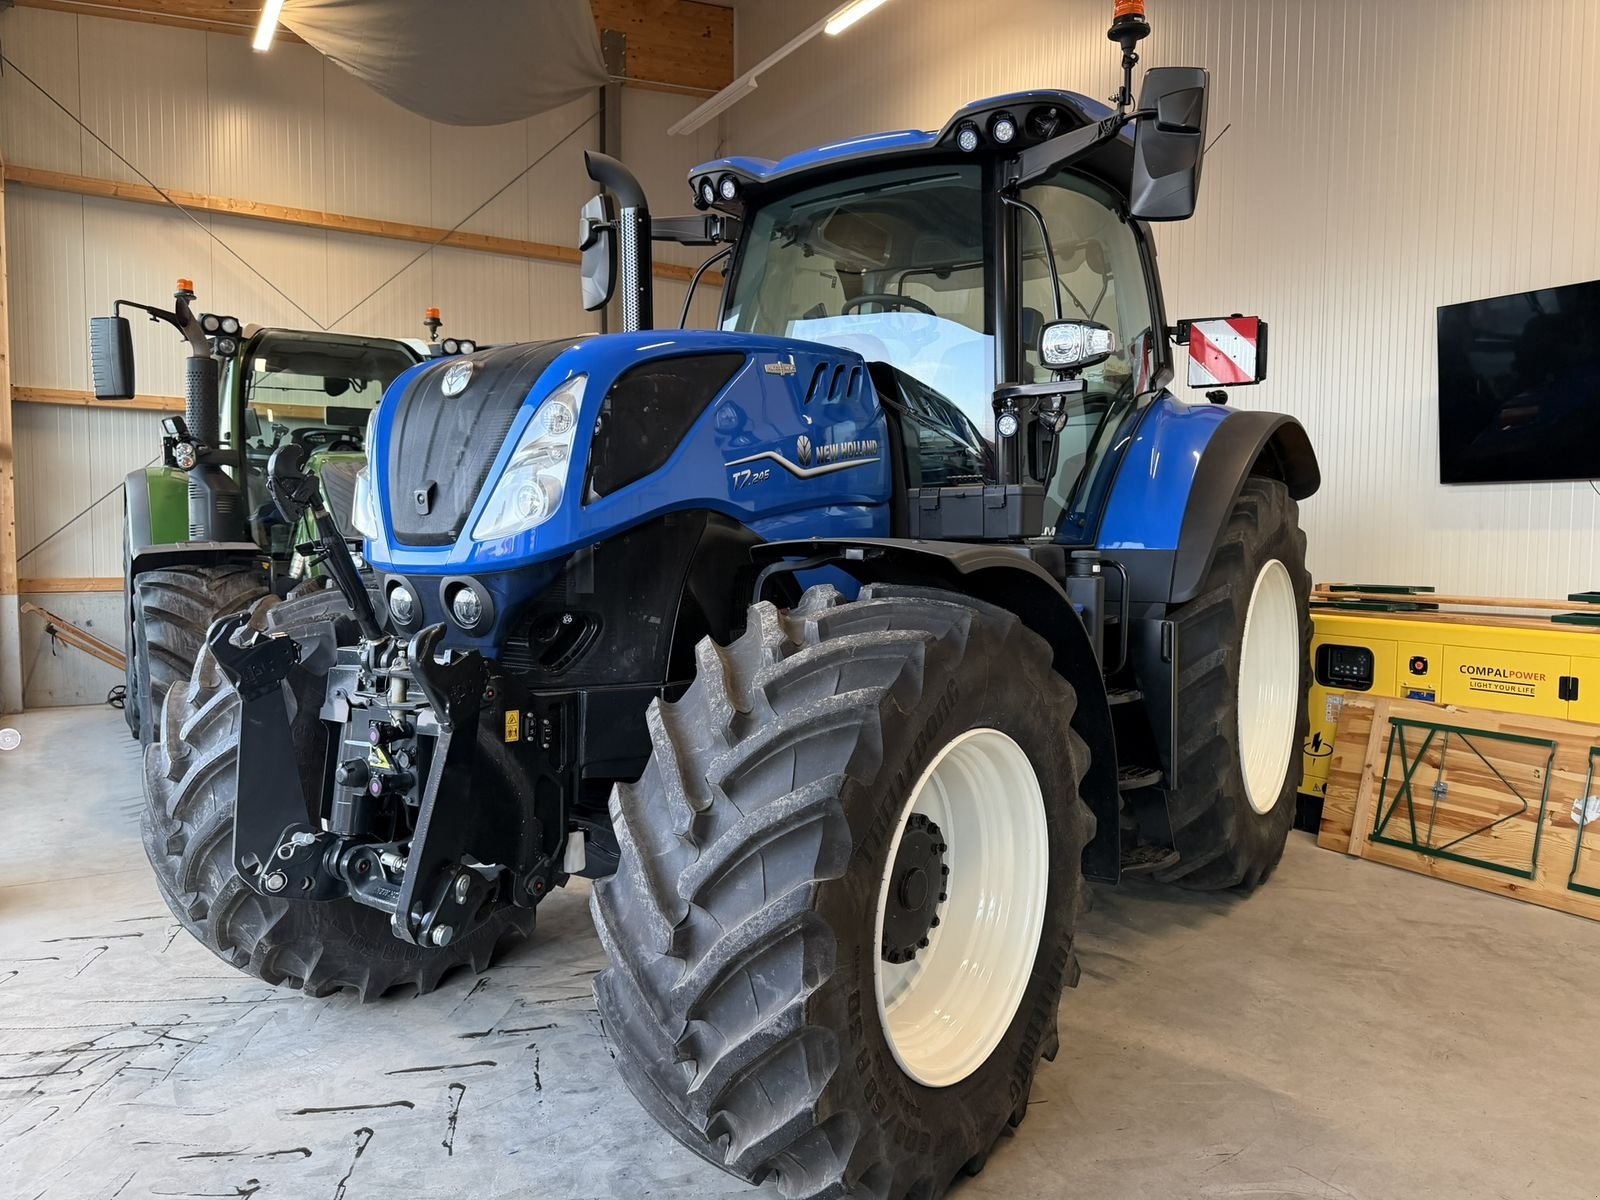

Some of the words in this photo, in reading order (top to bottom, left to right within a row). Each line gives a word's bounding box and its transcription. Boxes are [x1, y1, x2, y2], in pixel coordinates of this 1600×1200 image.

[815, 445, 838, 464] NEW
[840, 439, 878, 459] HOLLAND
[1469, 681, 1492, 689] LIGHT
[1494, 684, 1516, 692] YOUR
